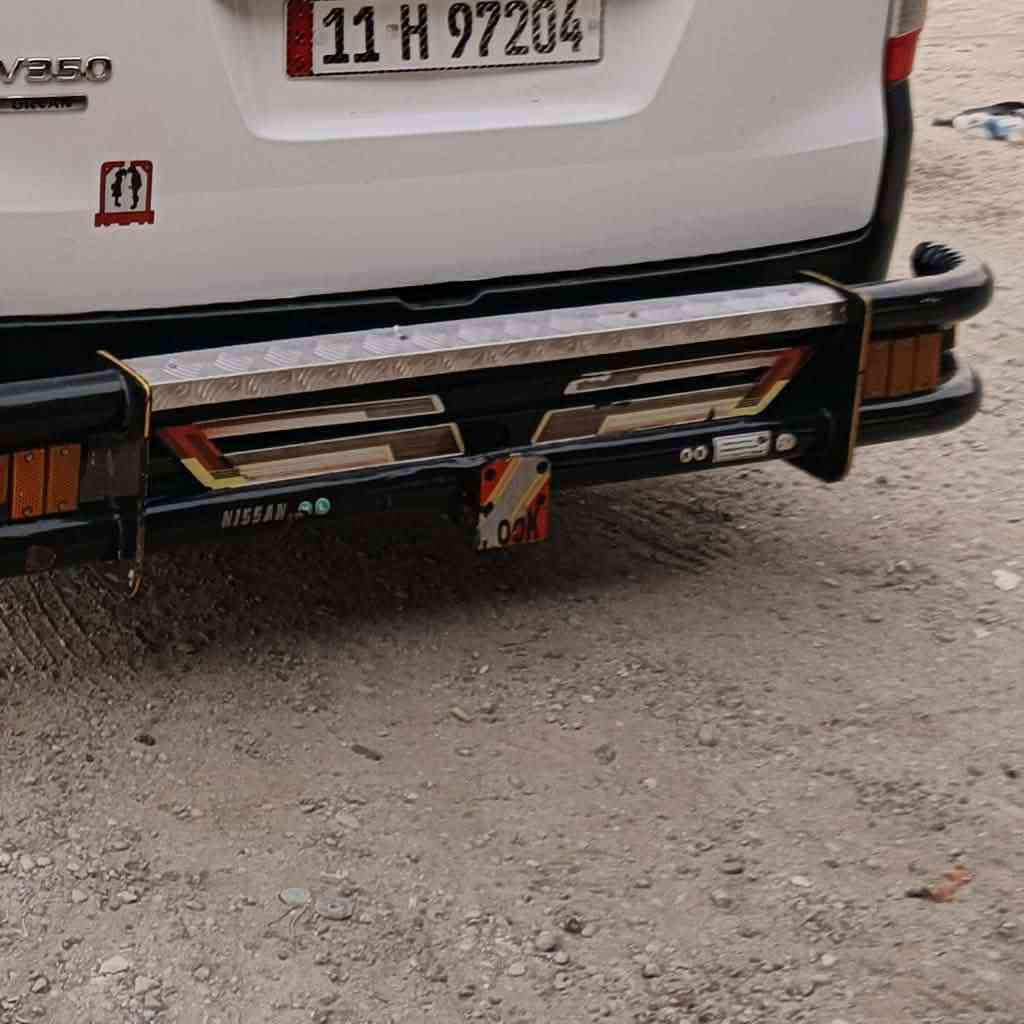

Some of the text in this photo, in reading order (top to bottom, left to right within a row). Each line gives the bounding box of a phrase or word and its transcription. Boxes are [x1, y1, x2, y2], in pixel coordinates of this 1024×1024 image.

[322, 5, 379, 64] 11
[400, 3, 429, 61] H
[221, 503, 287, 529] NISSAN
